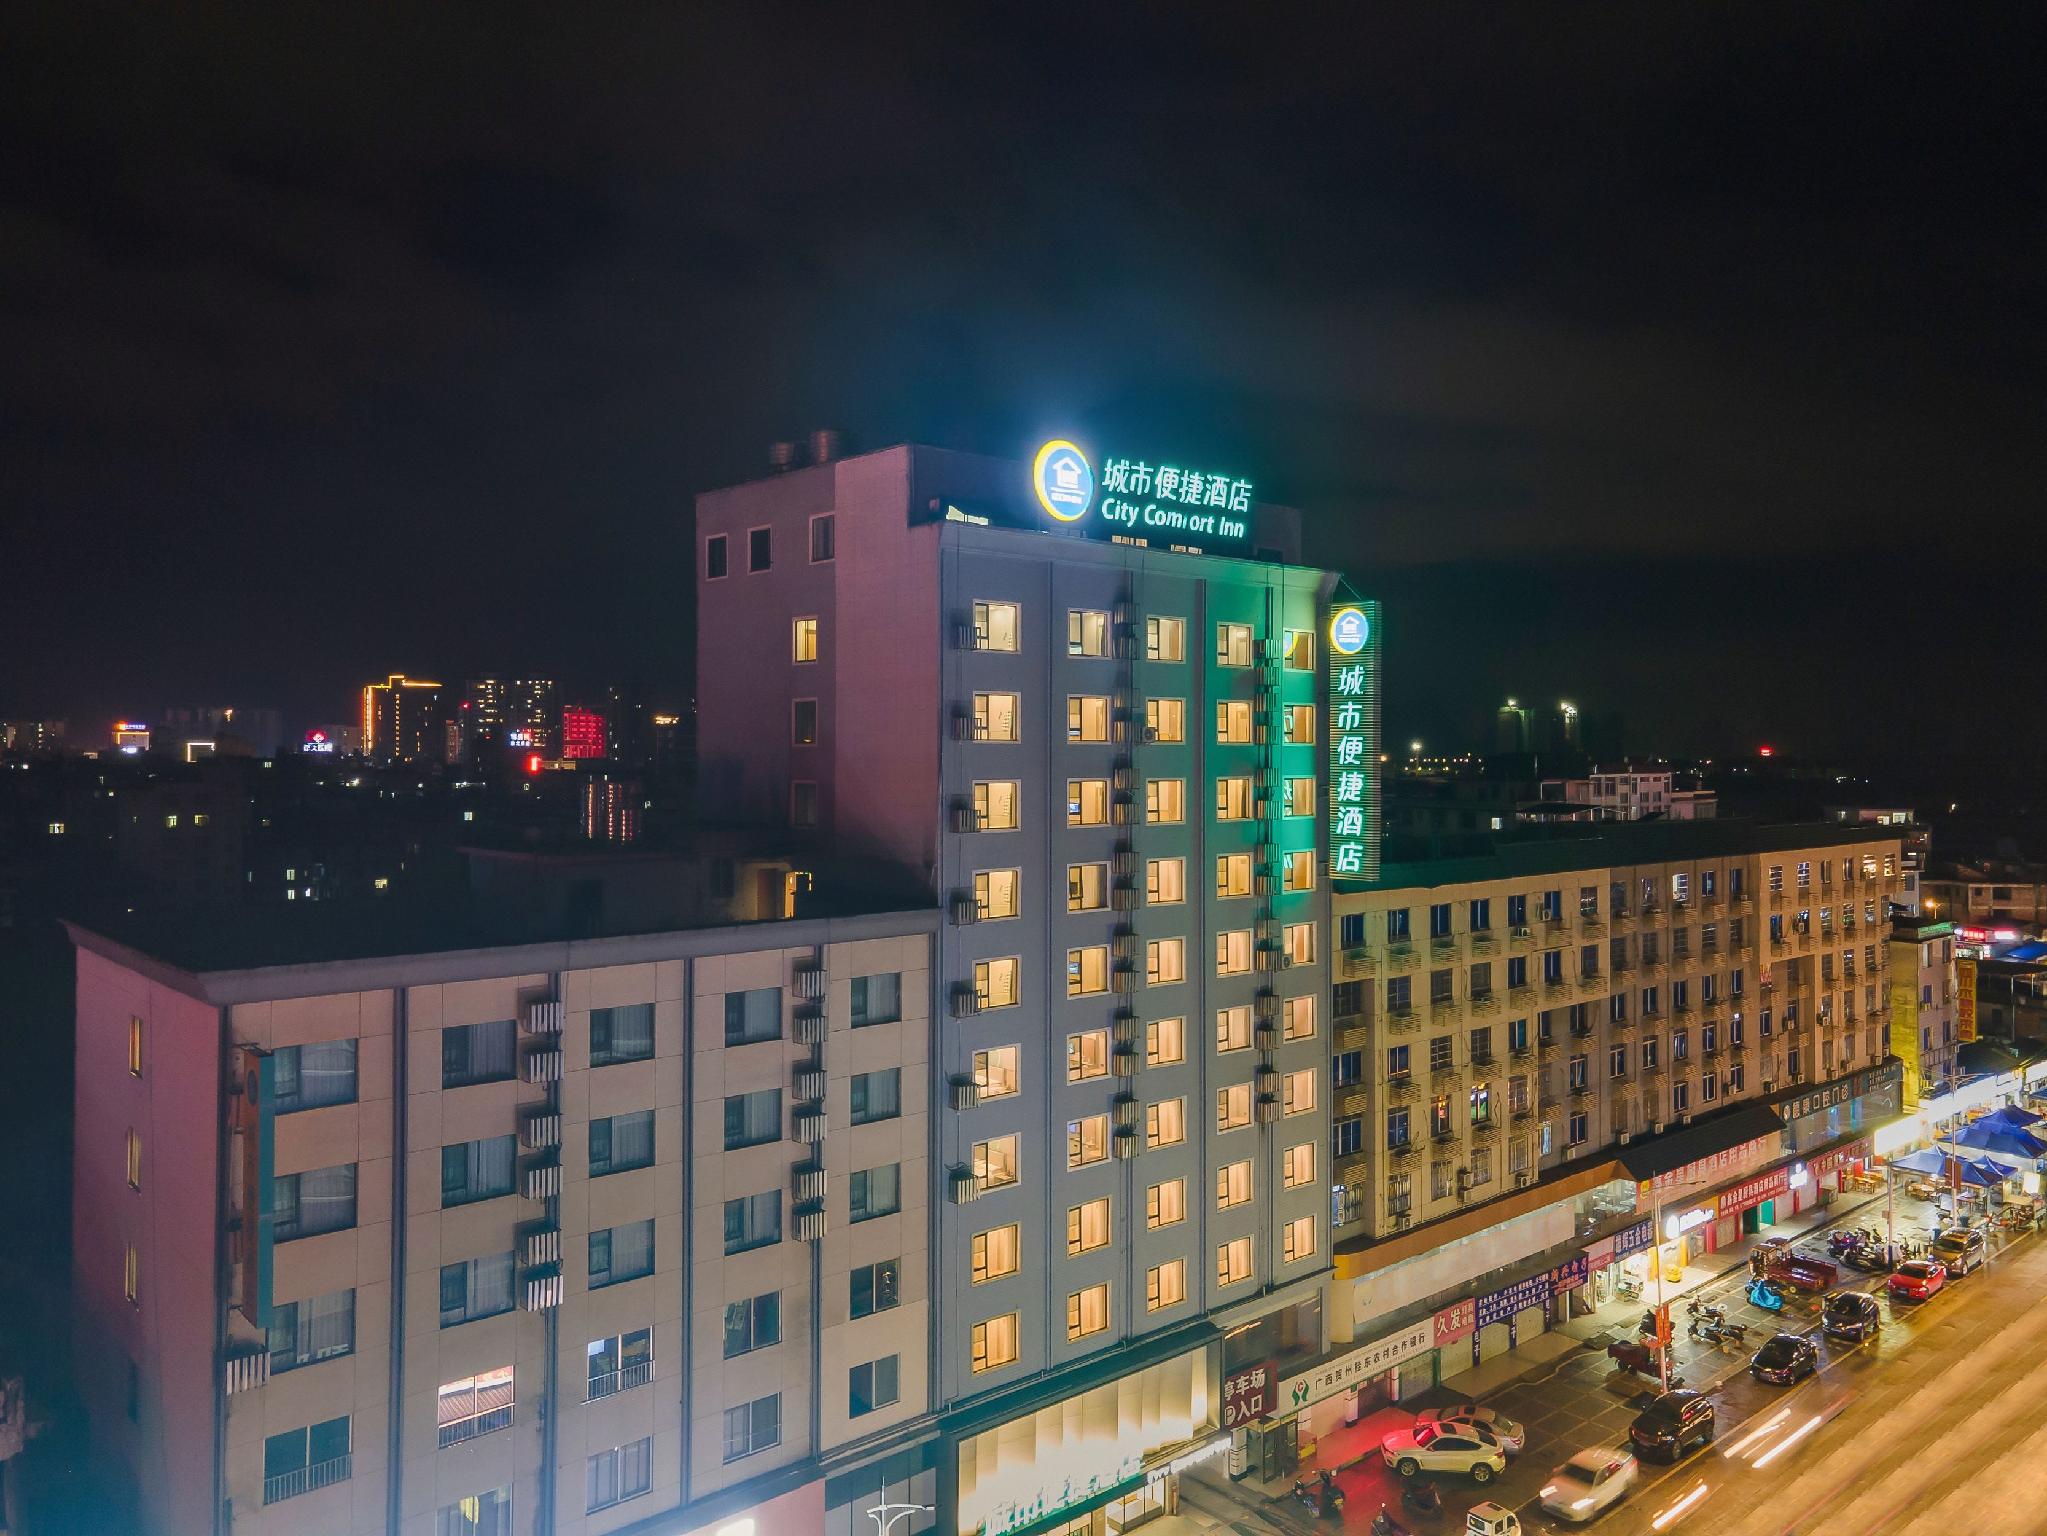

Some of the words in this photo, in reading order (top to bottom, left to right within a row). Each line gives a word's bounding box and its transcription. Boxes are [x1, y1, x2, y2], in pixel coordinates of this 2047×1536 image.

[1101, 458, 1253, 512] 城市便捷酒店
[1102, 498, 1140, 528] City
[1218, 516, 1244, 539] Inn
[1337, 665, 1365, 873] 城市便捷酒店
[1436, 1308, 1461, 1337] 久发
